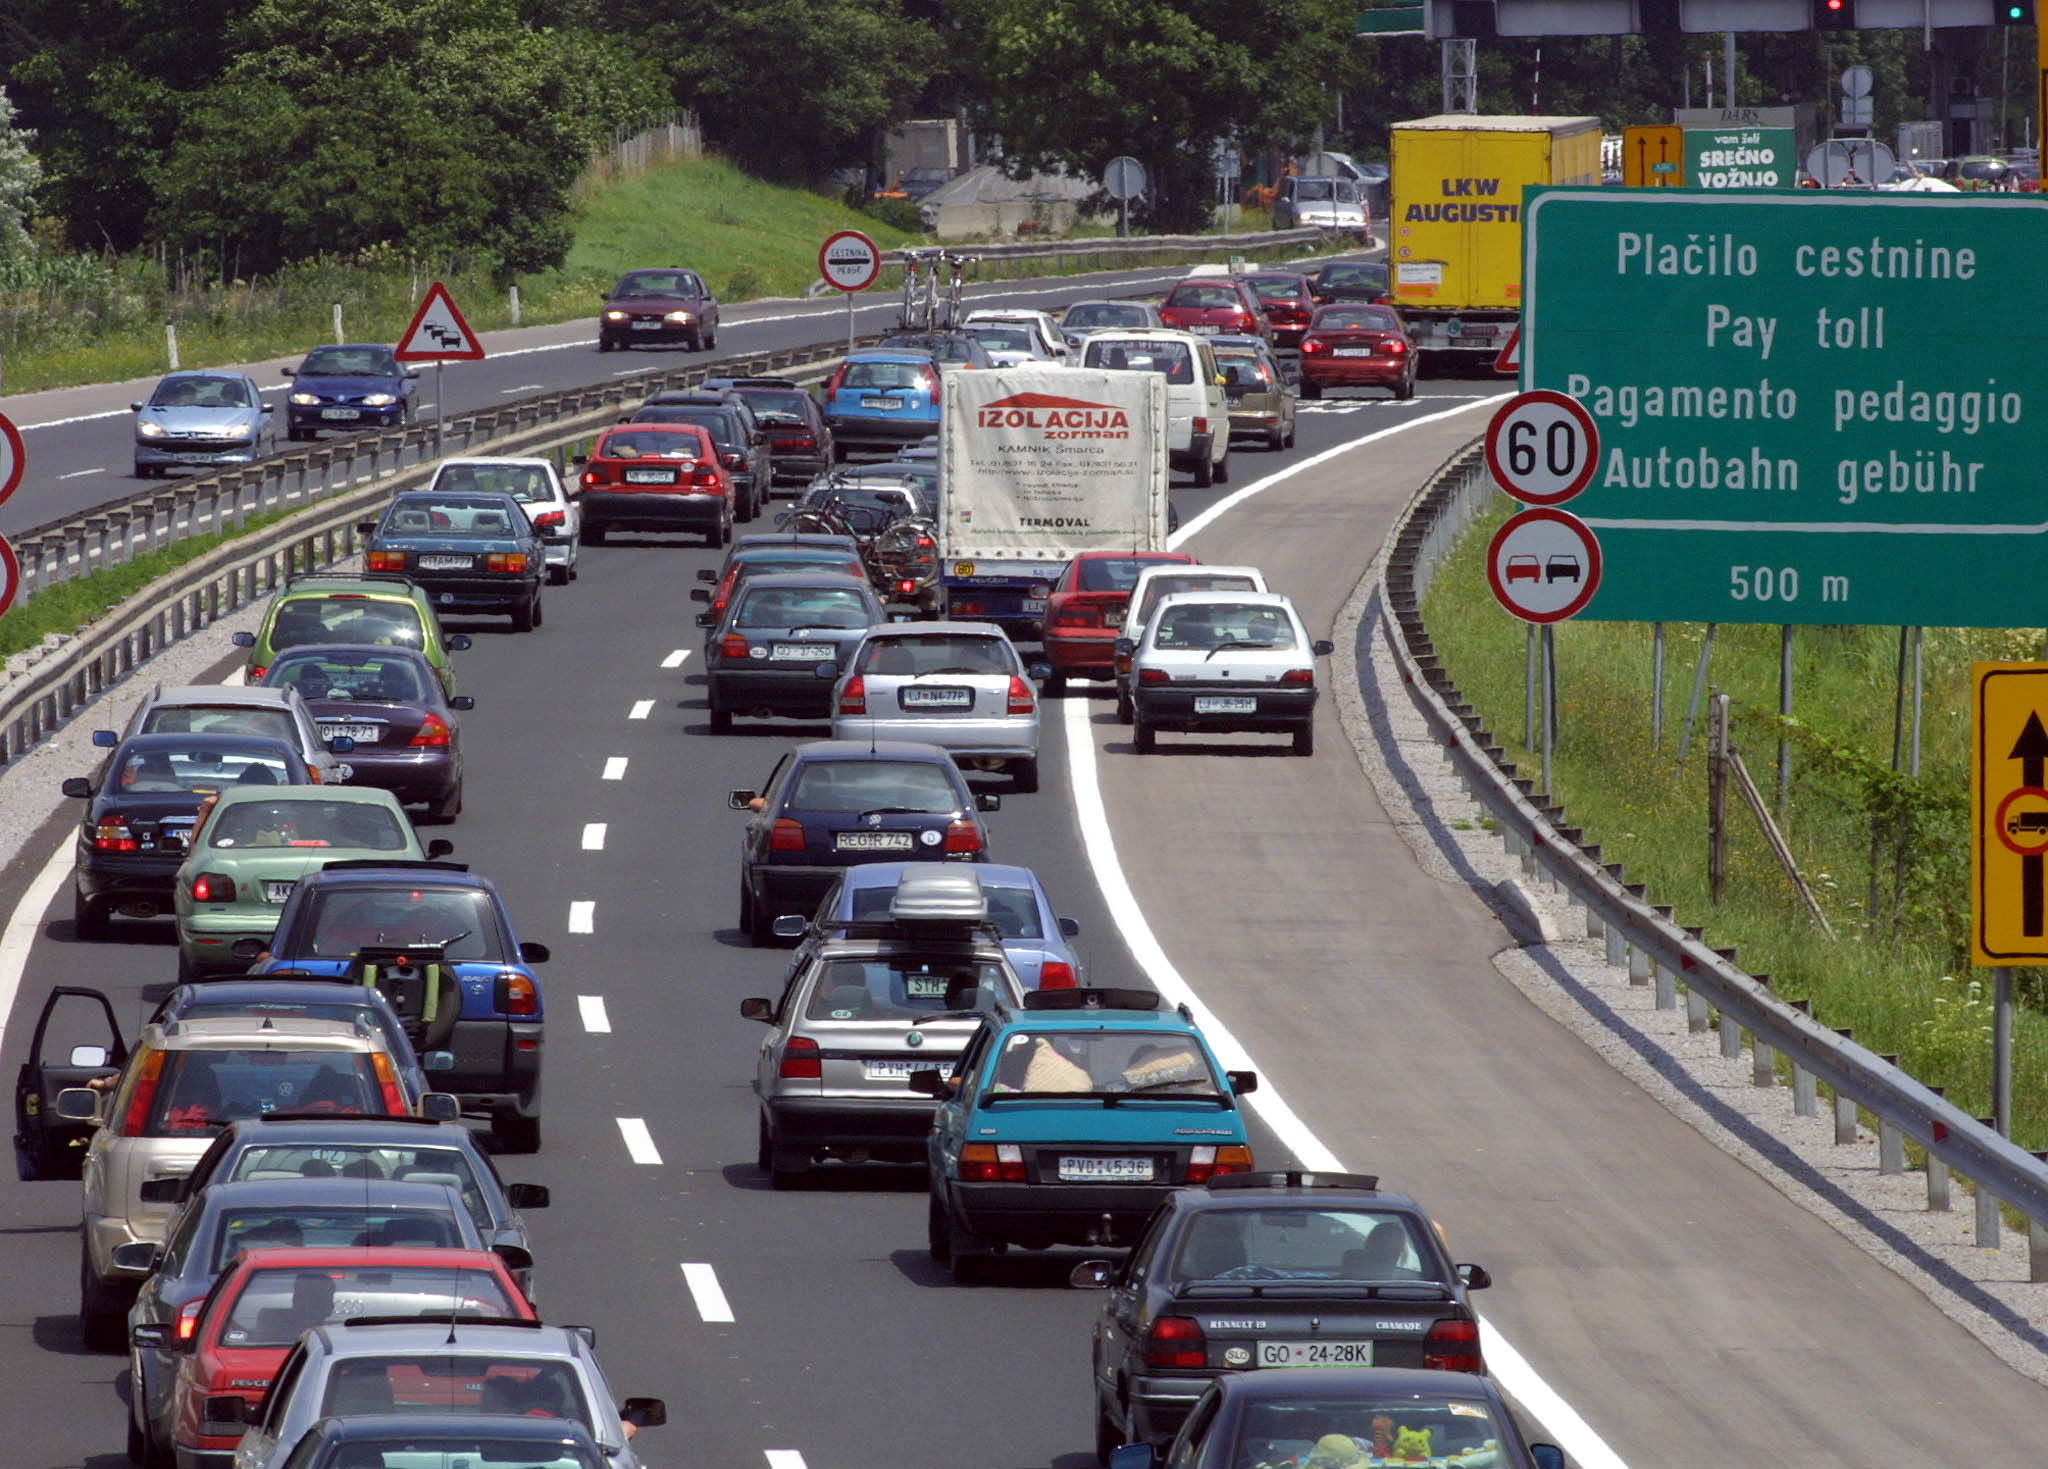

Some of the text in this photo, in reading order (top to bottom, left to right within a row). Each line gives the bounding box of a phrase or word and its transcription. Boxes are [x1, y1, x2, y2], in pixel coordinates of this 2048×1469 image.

[1714, 136, 1738, 144] vam
[1700, 147, 1774, 167] SREČNO
[1442, 178, 1499, 196] LKW
[1697, 168, 1778, 188] VOŽNJO
[1618, 232, 1976, 280] Plačilo cestnine
[1706, 304, 1884, 360] Pay toll
[1567, 374, 2021, 434] Pagamento pedaggio
[978, 410, 1129, 428] IZOLACIJA
[1043, 430, 1129, 440] zorman
[997, 445, 1051, 455] KAMNIK
[1508, 420, 1577, 477] 60
[1603, 446, 1985, 505] Autobahn gebühr
[1020, 517, 1090, 528] TERMOVAL
[1731, 566, 1850, 602] 500 m
[839, 834, 910, 846] REG R 742
[927, 833, 935, 843] D
[1210, 1320, 1253, 1328] RENAULT
[1264, 1345, 1368, 1363] GO 24-28K
